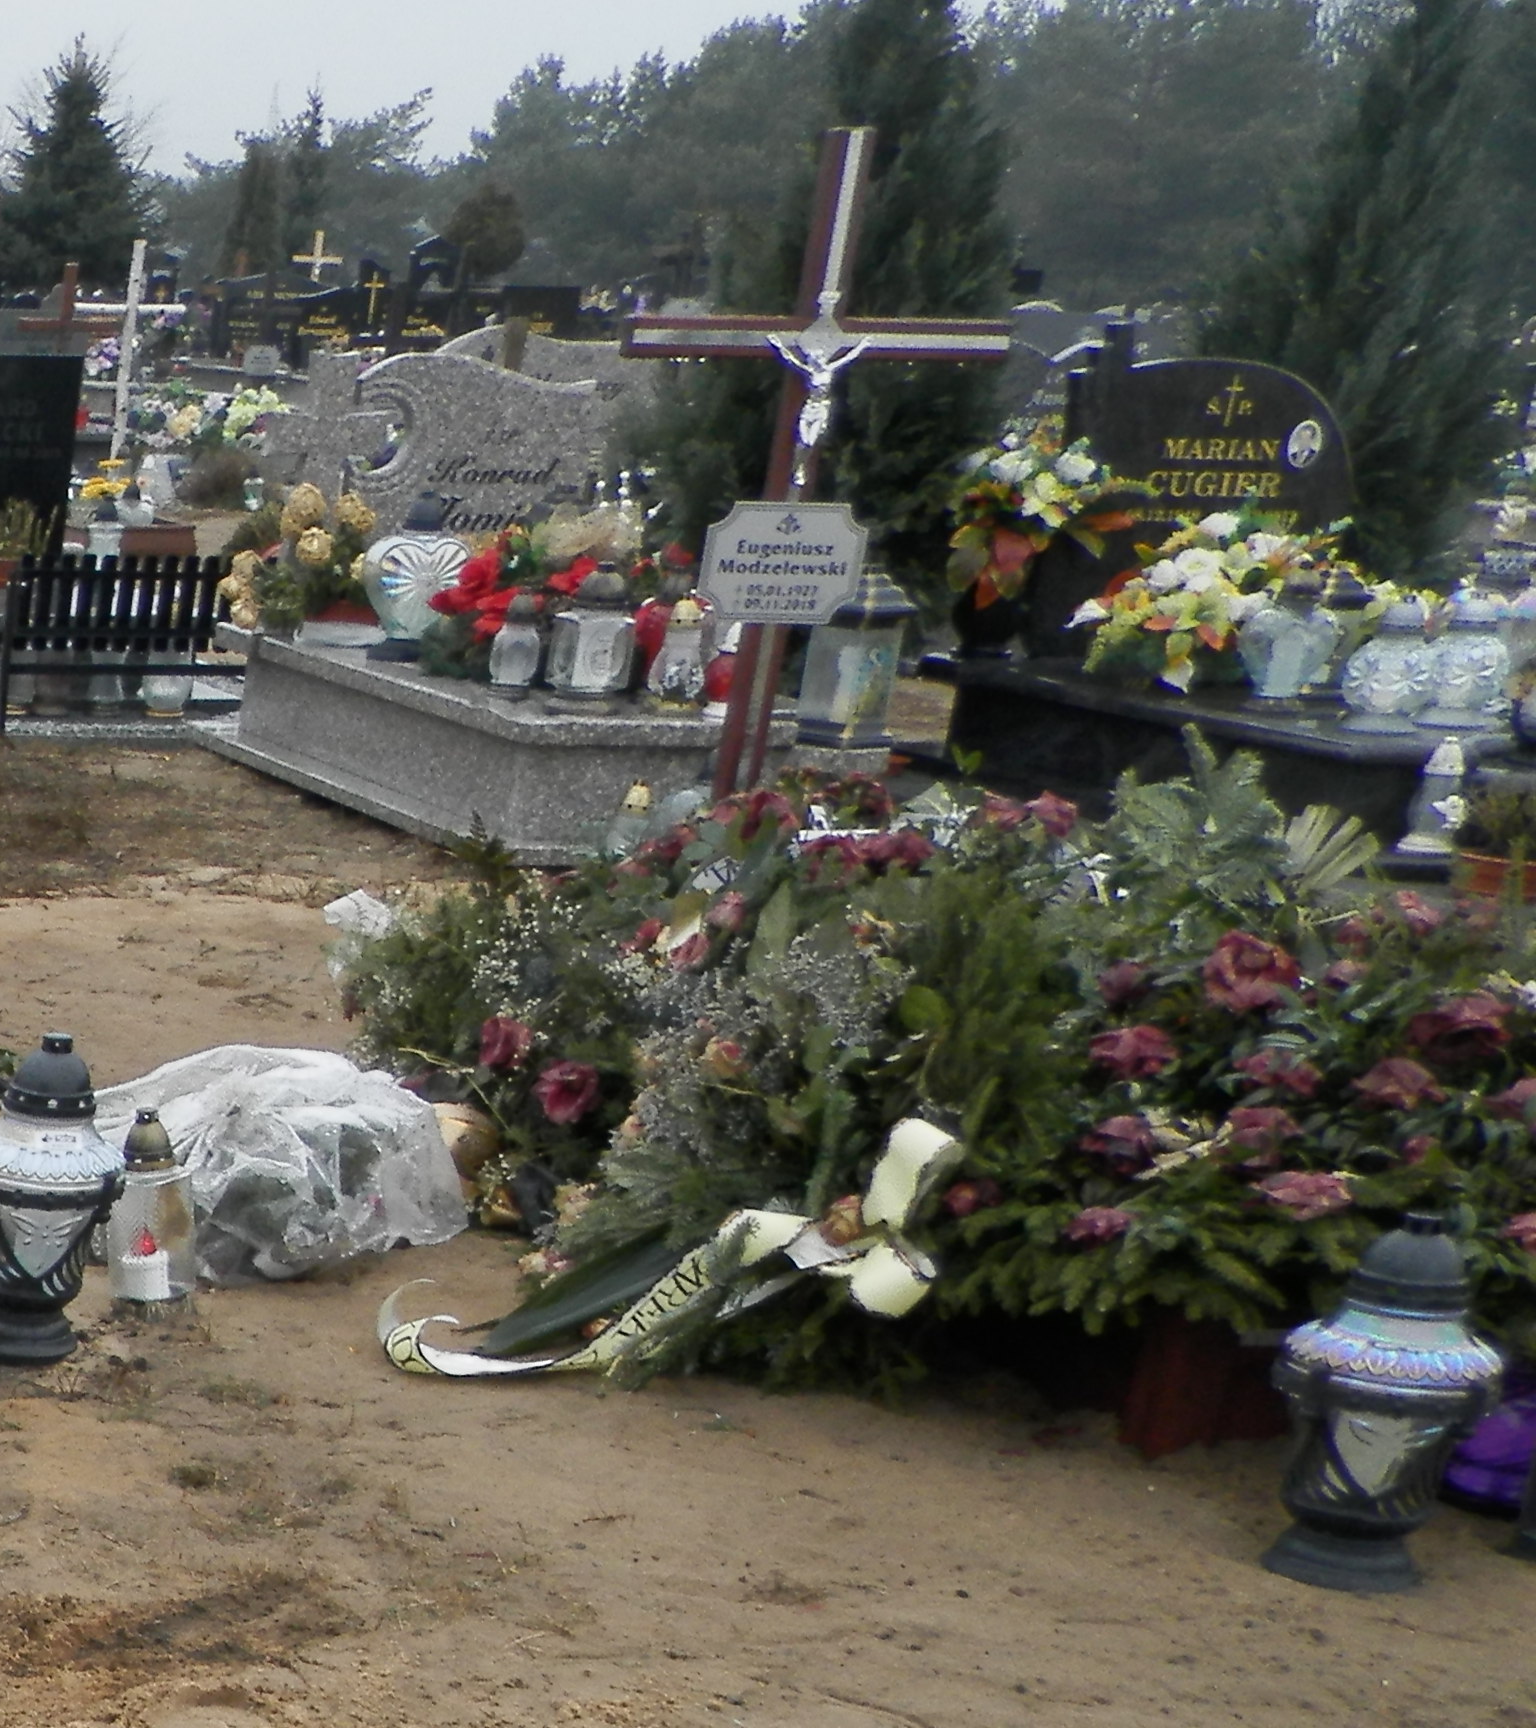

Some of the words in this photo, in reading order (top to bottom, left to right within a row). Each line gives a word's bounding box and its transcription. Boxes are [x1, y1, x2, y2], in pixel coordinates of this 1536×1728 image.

[1162, 438, 1280, 460] MARIAN
[428, 455, 560, 485] Konrad
[1148, 470, 1283, 498] CUGIER
[736, 539, 834, 559] Eugeniusz
[717, 559, 848, 576] Modzelewski
